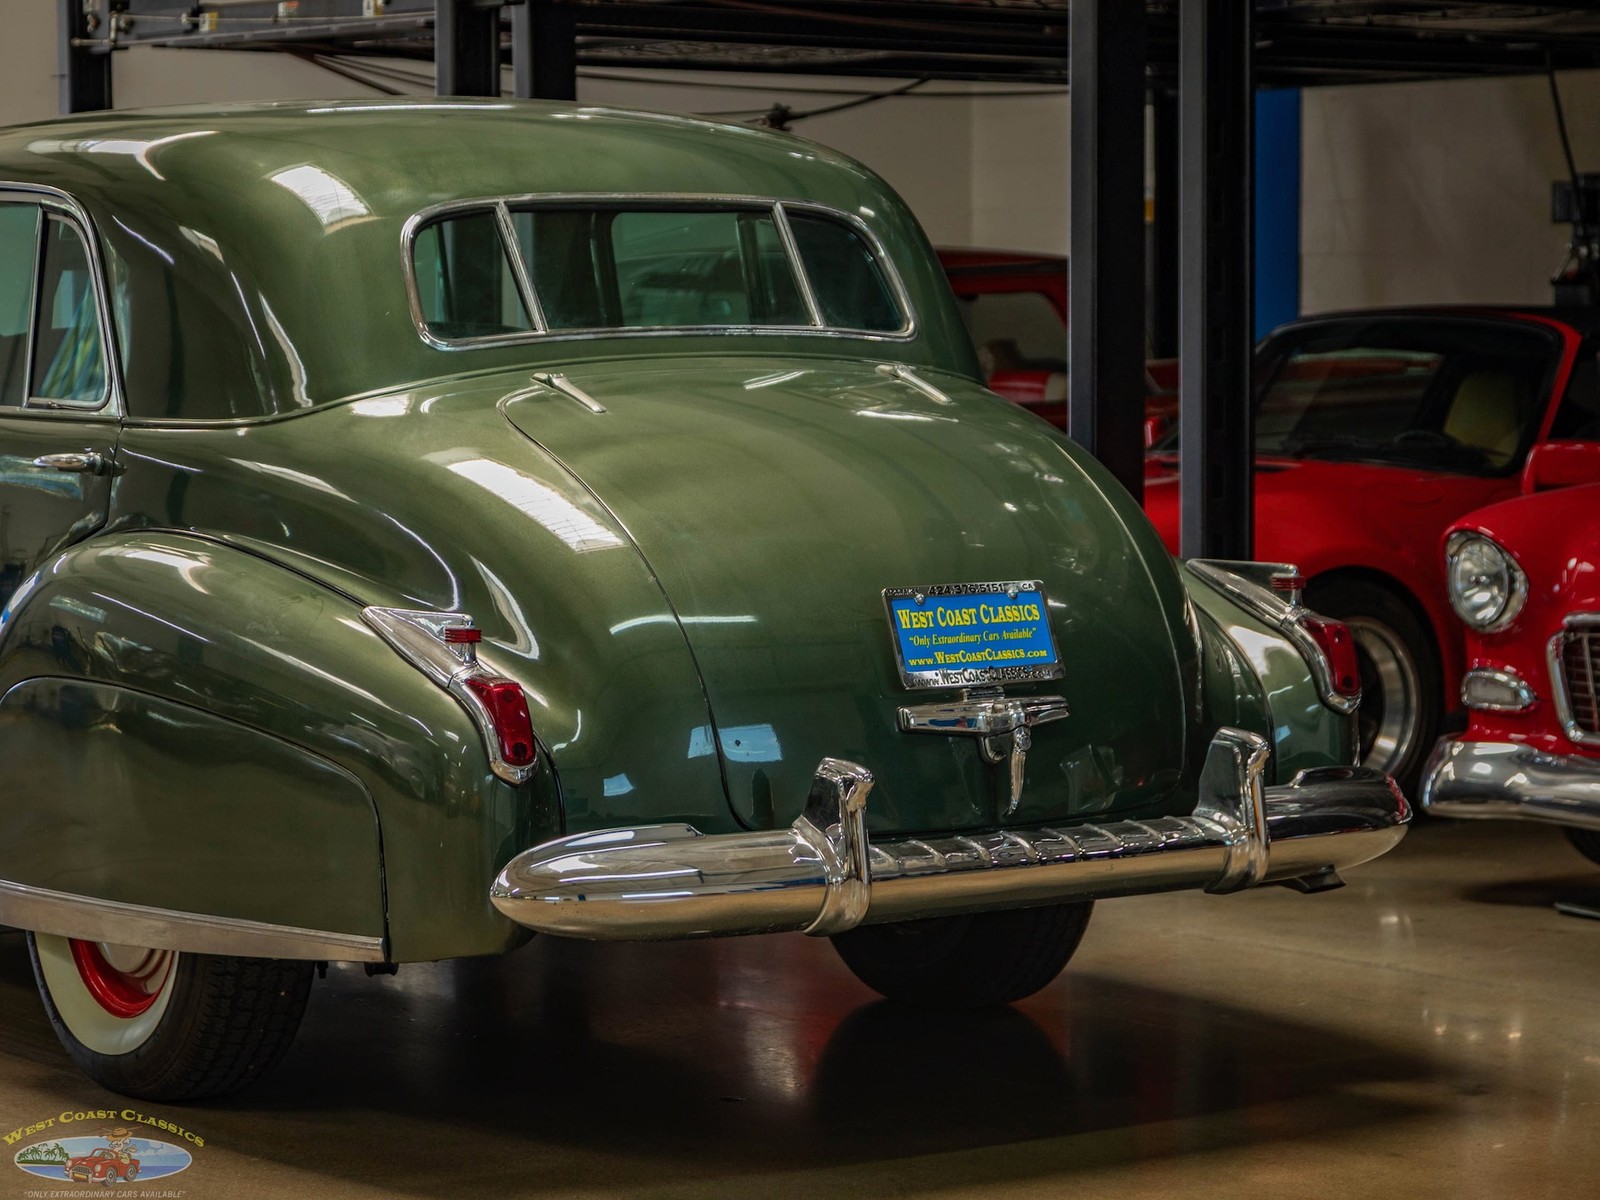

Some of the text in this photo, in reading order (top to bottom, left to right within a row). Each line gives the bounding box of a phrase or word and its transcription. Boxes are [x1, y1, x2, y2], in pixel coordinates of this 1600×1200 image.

[1022, 582, 1034, 591] CA
[897, 603, 1040, 629] WEST COAST CLASSICS
[933, 632, 981, 645] Extraordinary
[983, 630, 1000, 641] Cars
